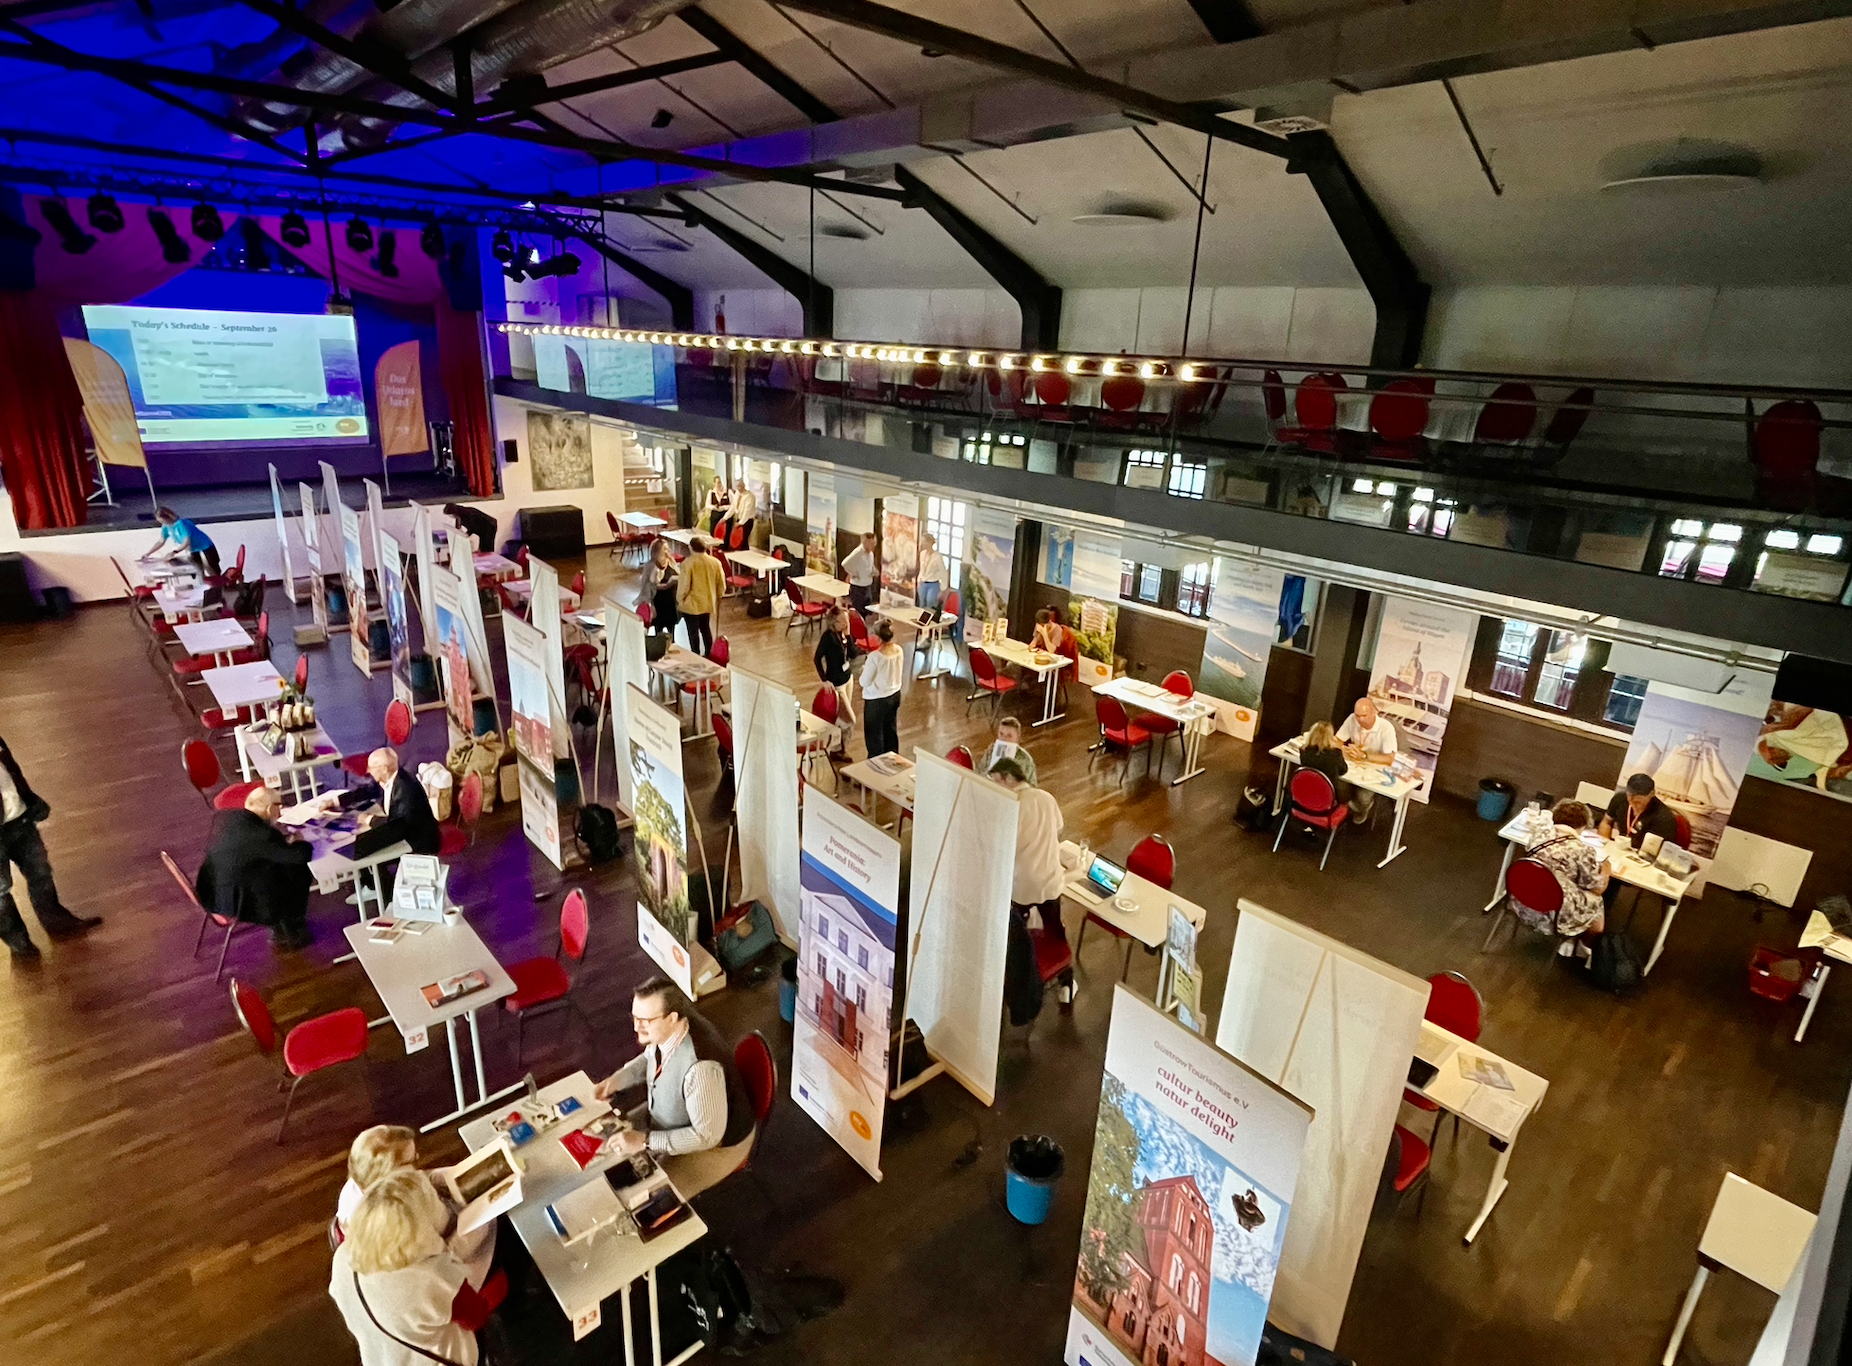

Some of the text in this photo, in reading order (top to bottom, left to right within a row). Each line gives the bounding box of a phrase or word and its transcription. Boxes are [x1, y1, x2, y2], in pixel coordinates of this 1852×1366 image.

[131, 320, 169, 332] Today's
[170, 322, 210, 331] Schedule
[221, 324, 265, 333] September
[823, 844, 872, 883] Art and History
[408, 1032, 424, 1046] 32
[1155, 1080, 1236, 1144] natur delight
[1157, 1067, 1239, 1130] cultur beauty
[578, 1310, 598, 1330] 33
